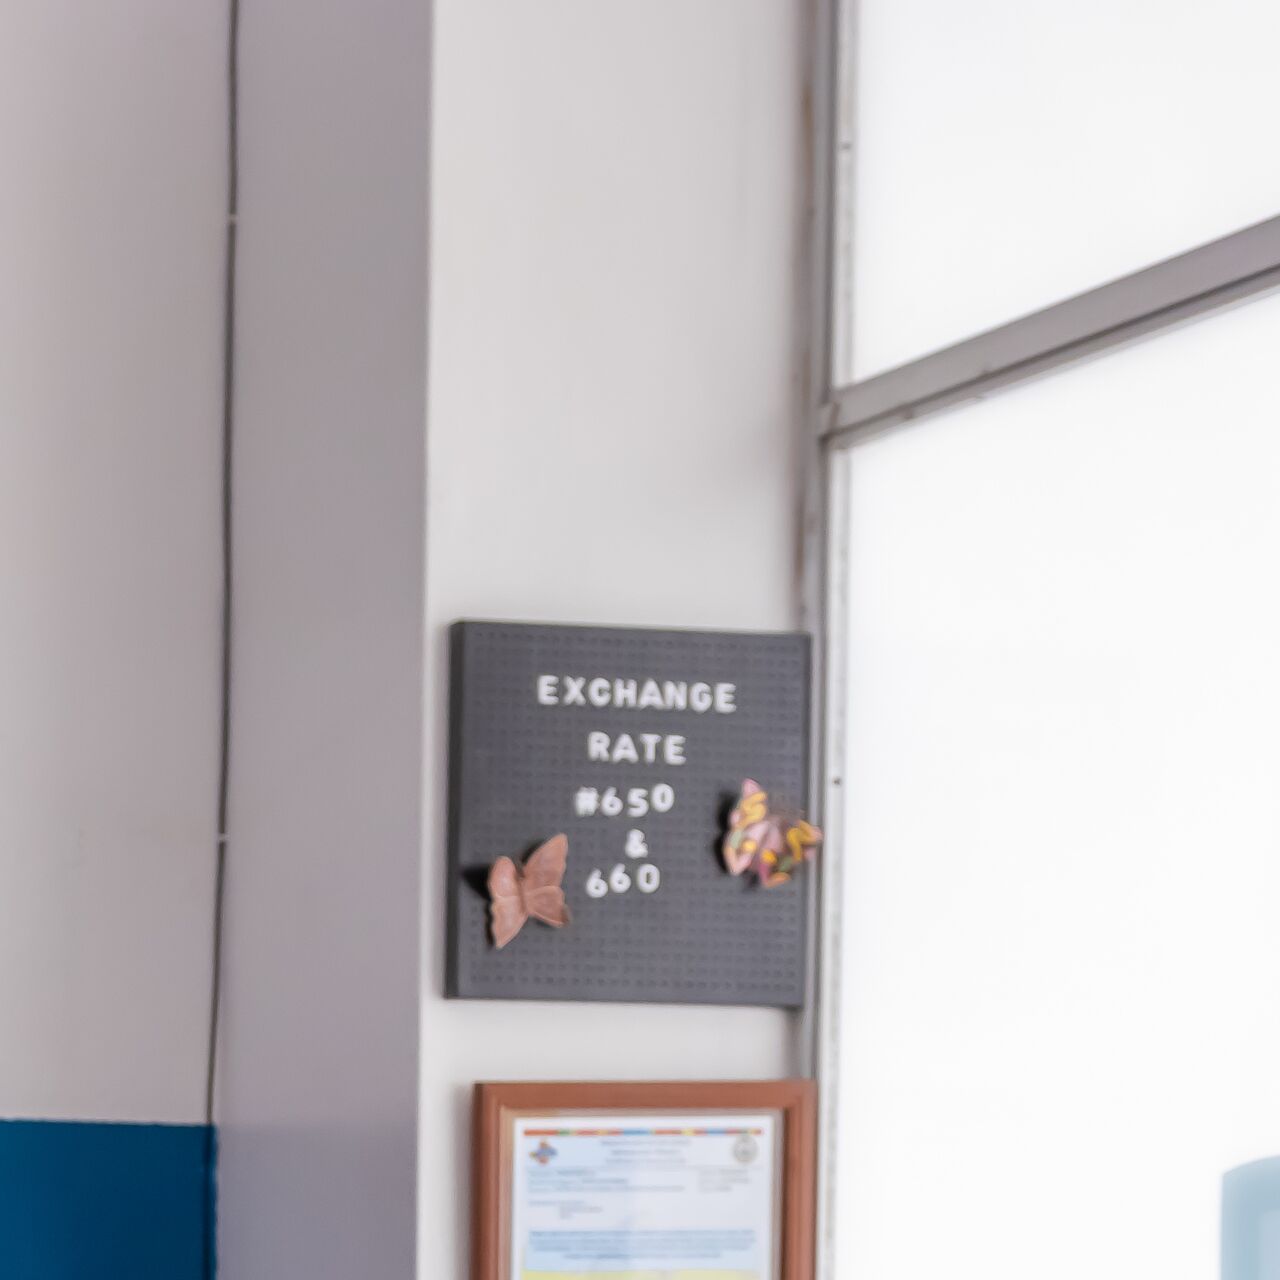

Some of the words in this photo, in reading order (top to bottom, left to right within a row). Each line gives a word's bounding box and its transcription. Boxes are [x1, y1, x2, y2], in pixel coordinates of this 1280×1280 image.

[537, 675, 737, 713] EXCHANGE
[587, 731, 687, 765] RATE
[625, 828, 648, 859] &
[586, 863, 661, 898] 660
